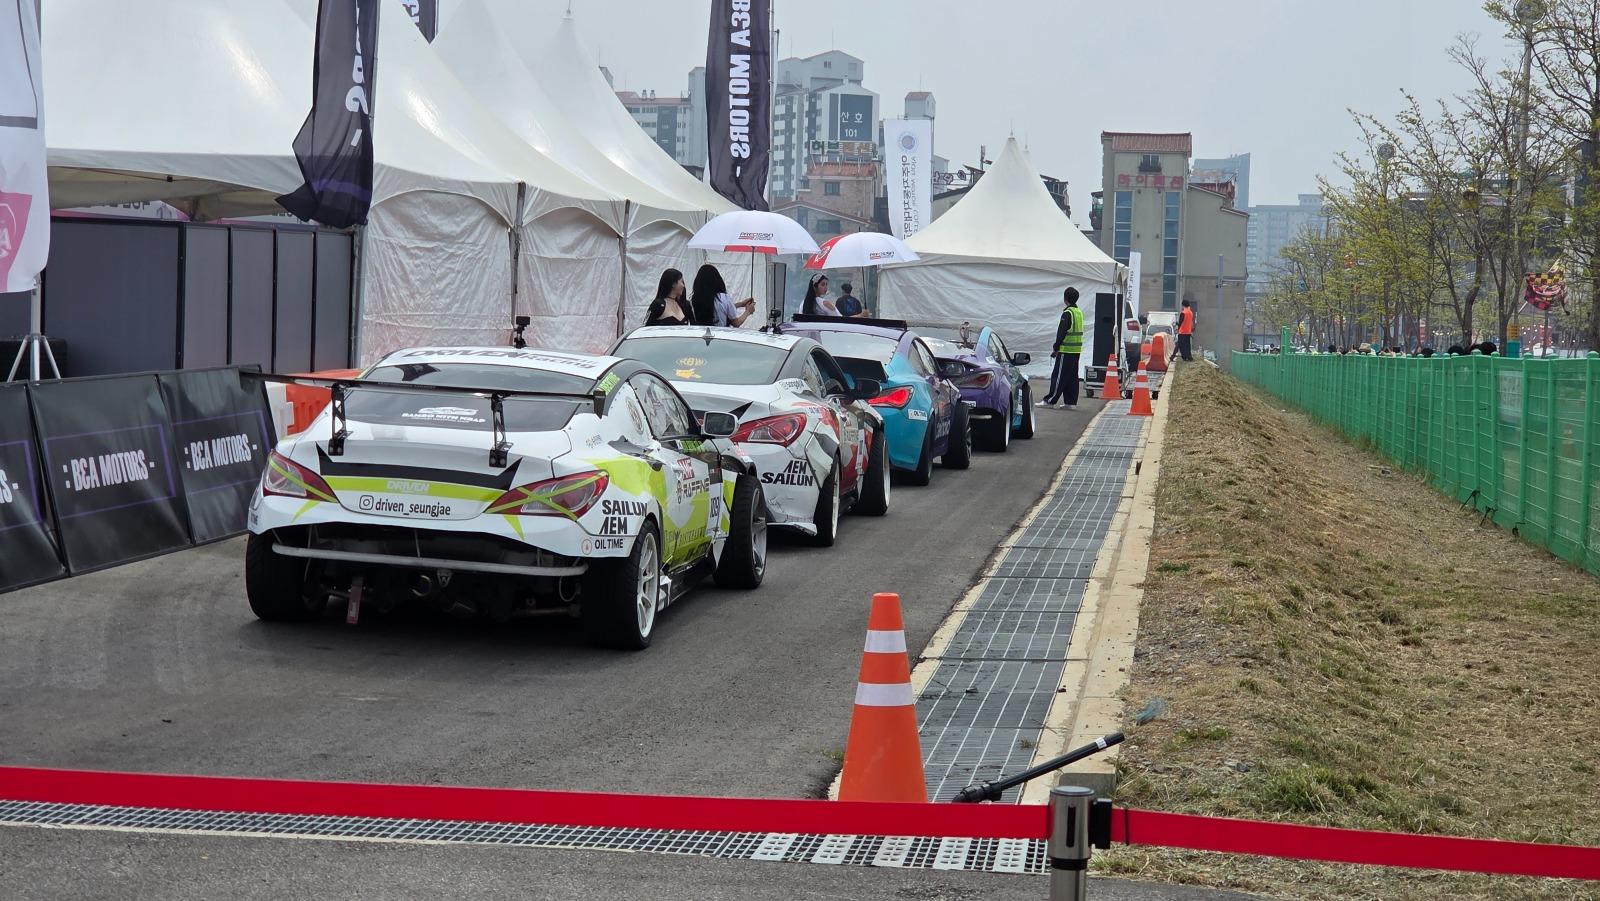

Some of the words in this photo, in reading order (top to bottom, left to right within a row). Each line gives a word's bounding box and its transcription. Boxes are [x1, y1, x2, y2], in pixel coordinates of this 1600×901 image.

[845, 129, 857, 137] 101
[212, 434, 252, 467] MOTORS
[99, 449, 149, 486] MOTORS
[760, 472, 814, 487] SAILUN
[374, 498, 451, 518] driven_seungjae
[601, 499, 648, 517] SAILUN
[594, 539, 606, 550] OIL
[607, 538, 624, 549] TIME
